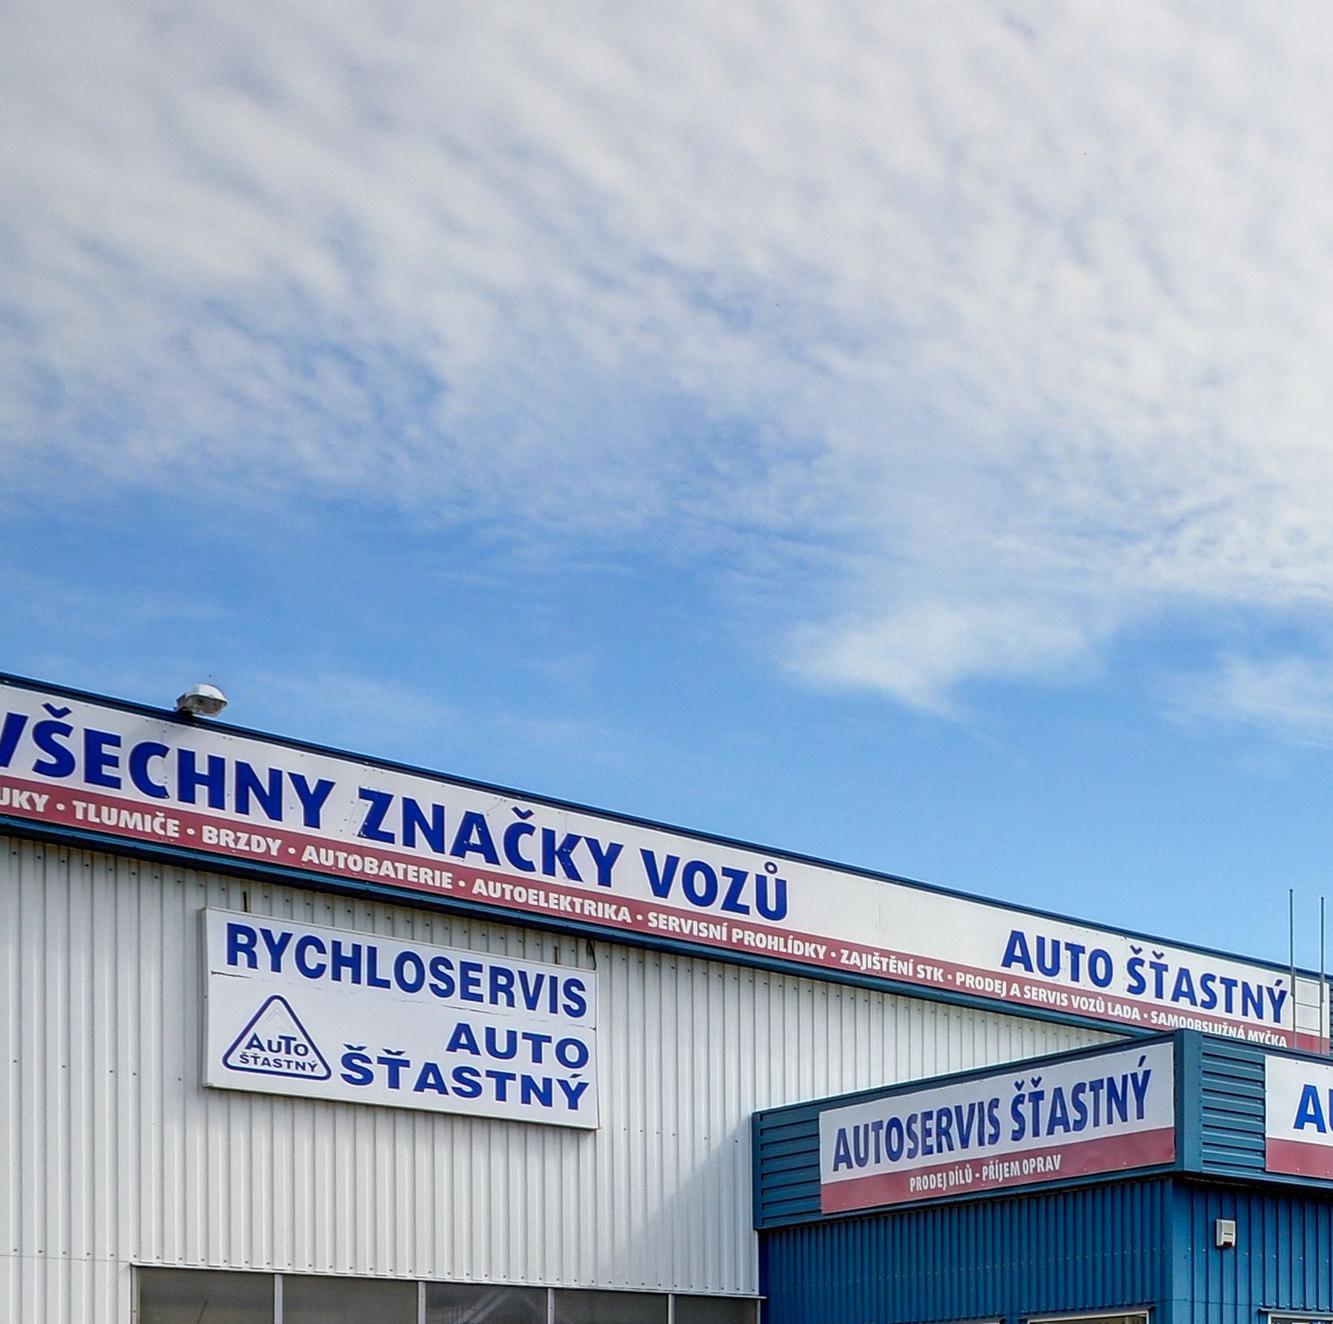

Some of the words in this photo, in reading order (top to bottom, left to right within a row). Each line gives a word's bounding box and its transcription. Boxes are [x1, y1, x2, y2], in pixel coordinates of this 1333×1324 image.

[358, 787, 624, 888] ZNAČKY
[640, 848, 788, 921] VOZŮ
[72, 800, 180, 837] TLUMIČE
[202, 825, 282, 856] BRZDY
[301, 845, 453, 889] AUTOBATERIE
[472, 879, 632, 924] AUTOELEKTRIKA
[648, 911, 728, 942] SERVISNÍ
[731, 928, 827, 960] PROHLÍDKY
[840, 949, 913, 977] ZAJIŠTĚNÍ
[916, 963, 944, 982] STK
[955, 972, 1007, 998] PRODEJ
[1010, 983, 1021, 999] A
[1023, 985, 1068, 1007] SERVIS
[1071, 994, 1105, 1013] VOZŮ
[1108, 1002, 1141, 1020] LADA
[1247, 1029, 1287, 1048] MYČKA
[226, 922, 588, 1018] RYCHLOSERVIS
[1000, 929, 1113, 988] AUTO
[1126, 945, 1288, 1024] ŠŤASTNÝ
[239, 1052, 318, 1072] ŠŤASTNÝ
[340, 1043, 589, 1110] ŠŤASTNÝ
[446, 1022, 589, 1069] AUTO
[832, 1097, 1000, 1172] AUTOSERVIS
[1011, 1055, 1152, 1142] ŠŤASTNÝ
[909, 1172, 948, 1192] PRODEJ
[949, 1163, 973, 1187] DÍLŮ
[982, 1158, 1020, 1182] PŘÍJEM
[1022, 1154, 1062, 1174] OPRAV
